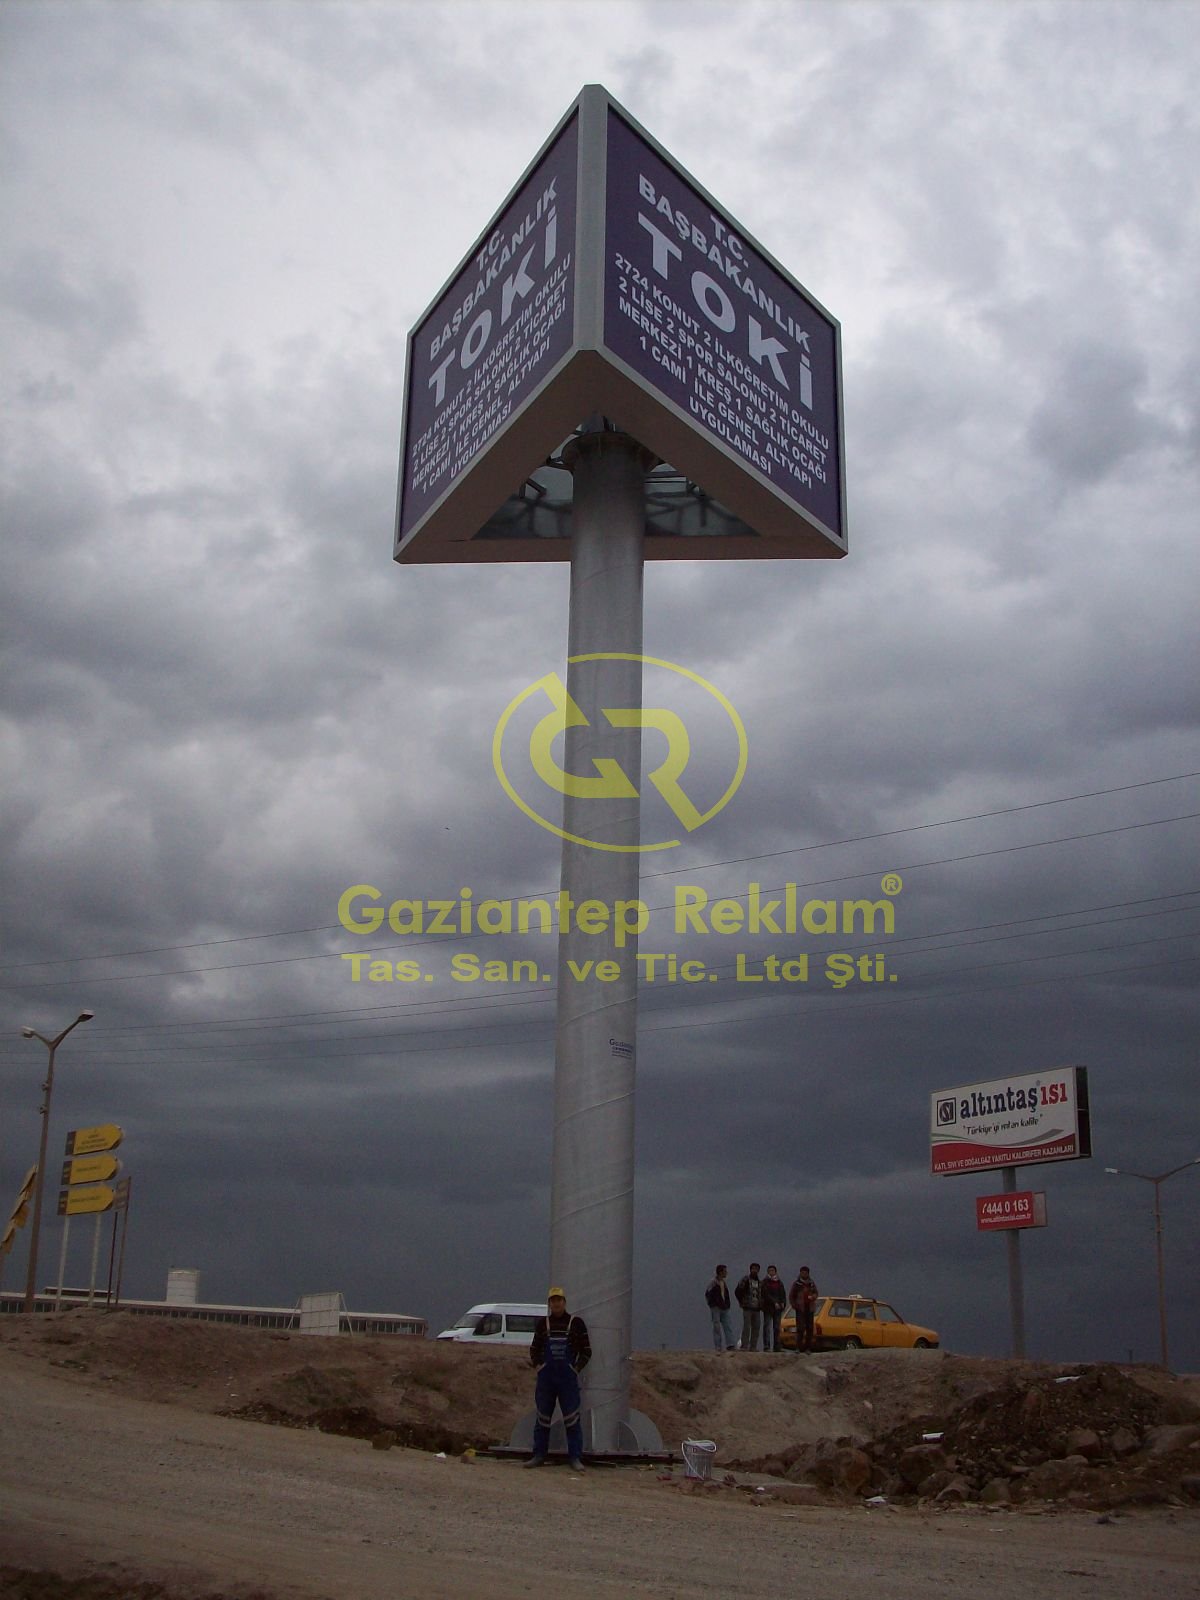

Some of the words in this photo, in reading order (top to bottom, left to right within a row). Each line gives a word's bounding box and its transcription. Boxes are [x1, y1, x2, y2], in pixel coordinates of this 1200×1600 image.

[428, 204, 557, 408] TOKİ
[430, 175, 557, 361] BAŞBAKANLIK
[476, 230, 504, 272] T.C.
[638, 211, 812, 411] TOKİ
[639, 173, 810, 353] BAŞBAKANLIK
[711, 214, 749, 268] T.C.
[412, 426, 432, 458] 2724
[434, 388, 464, 433] KONUT
[466, 380, 472, 394] 2
[474, 302, 532, 385] İLKÖĞRETİM
[536, 252, 570, 308] OKULU
[412, 436, 450, 490] MERKEZİ
[453, 430, 456, 443] 1
[460, 399, 484, 436] KREŞ
[486, 390, 490, 402] 1
[494, 342, 530, 394] SAĞLIK
[532, 297, 566, 346] OCAĞI
[414, 461, 418, 472] 2
[420, 435, 438, 464] LİSE
[441, 427, 446, 441] 2
[448, 396, 472, 432] SPOR
[474, 346, 512, 401] SALONU
[515, 336, 520, 352] 2
[524, 276, 568, 340] TİCARET
[422, 482, 426, 494] 1
[472, 395, 502, 438] GENEL
[508, 336, 550, 396] ALTYAPI
[450, 400, 512, 479] UYGULAMASI
[615, 252, 649, 291] 2724
[653, 285, 700, 335] KONUT
[704, 331, 712, 347] 2
[715, 337, 788, 415] İLKÖĞRETİM
[791, 409, 829, 450] OKULU
[619, 276, 627, 293] 2
[632, 286, 662, 324] LİSE
[667, 318, 674, 334] 2
[678, 328, 713, 368] SPOR
[717, 362, 766, 413] SALONU
[770, 408, 776, 424] 2
[780, 416, 826, 464] TİCARET
[620, 296, 682, 360] MERKEZİ
[687, 356, 692, 369] 1
[698, 363, 732, 404] KREŞ
[736, 398, 740, 411] 1
[746, 406, 788, 452] SAĞLIK
[792, 446, 826, 484] OCAĞI
[640, 336, 646, 351] 1
[718, 402, 759, 445] GENEL
[766, 442, 812, 489] ALTYAPI
[690, 396, 772, 474] UYGULAMASI
[960, 1086, 1038, 1119] altıntaş
[986, 1202, 1002, 1214] 444
[1004, 1201, 1010, 1212] 0
[1013, 1198, 1028, 1212] 163
